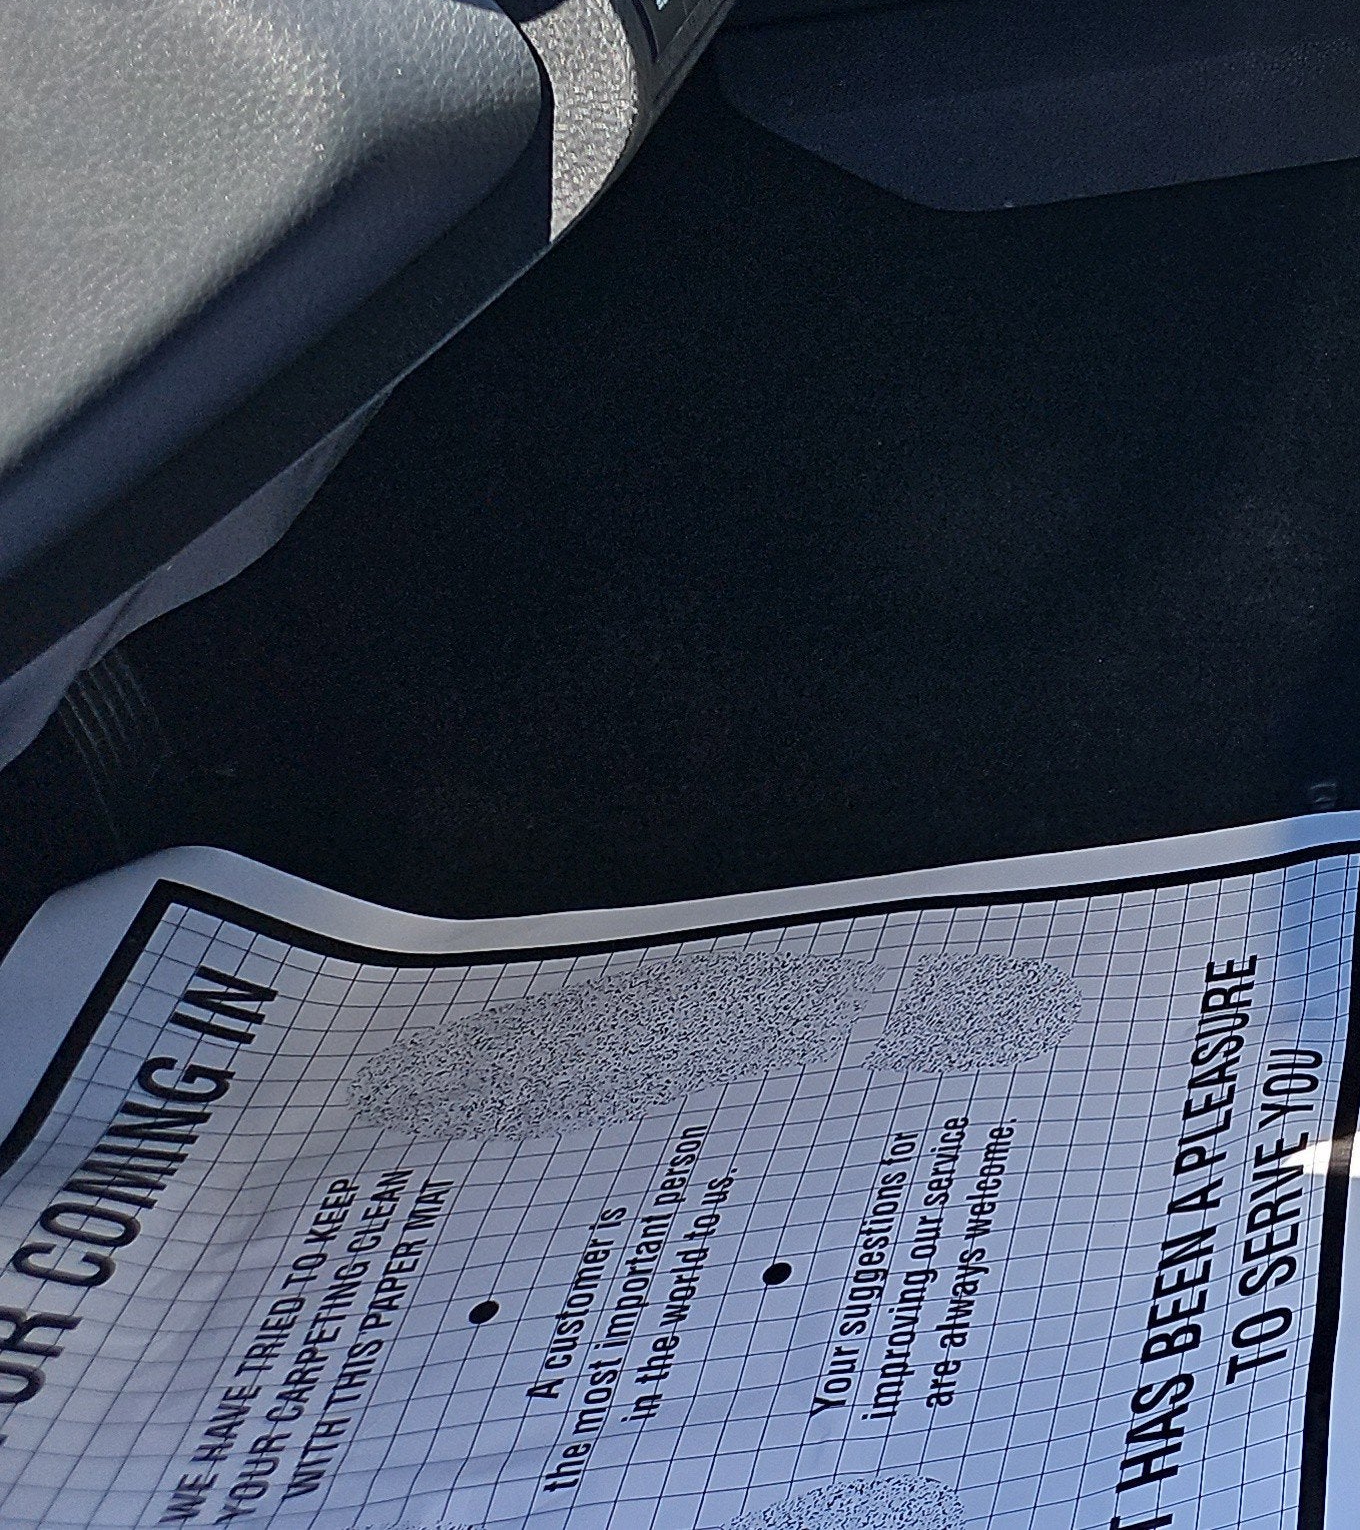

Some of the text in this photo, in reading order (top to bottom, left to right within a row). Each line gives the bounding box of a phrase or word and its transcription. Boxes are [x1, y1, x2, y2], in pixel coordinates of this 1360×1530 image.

[12, 1055, 236, 1288] COMING
[168, 966, 278, 1045] IN
[1167, 1178, 1224, 1215] A
[1173, 953, 1258, 1177] PLEASURE
[159, 1178, 359, 1524] WE HAVE TRIED TO KEEP
[212, 1168, 415, 1525] YOUR CARPETING CLEAN
[281, 1178, 455, 1502] WITH THIS PAPER MAT
[526, 1206, 627, 1400] A customer is
[543, 1124, 708, 1494] the most important person
[621, 1167, 738, 1423] in the world to us.
[809, 1131, 919, 1419] Your suggestions for
[861, 1116, 969, 1421] improving our service
[925, 1118, 1017, 1409] are always welcome.
[1140, 1231, 1211, 1364] BEEN
[1226, 1047, 1324, 1386] TO SERVE YOU
[1116, 1372, 1196, 1493] HAS
